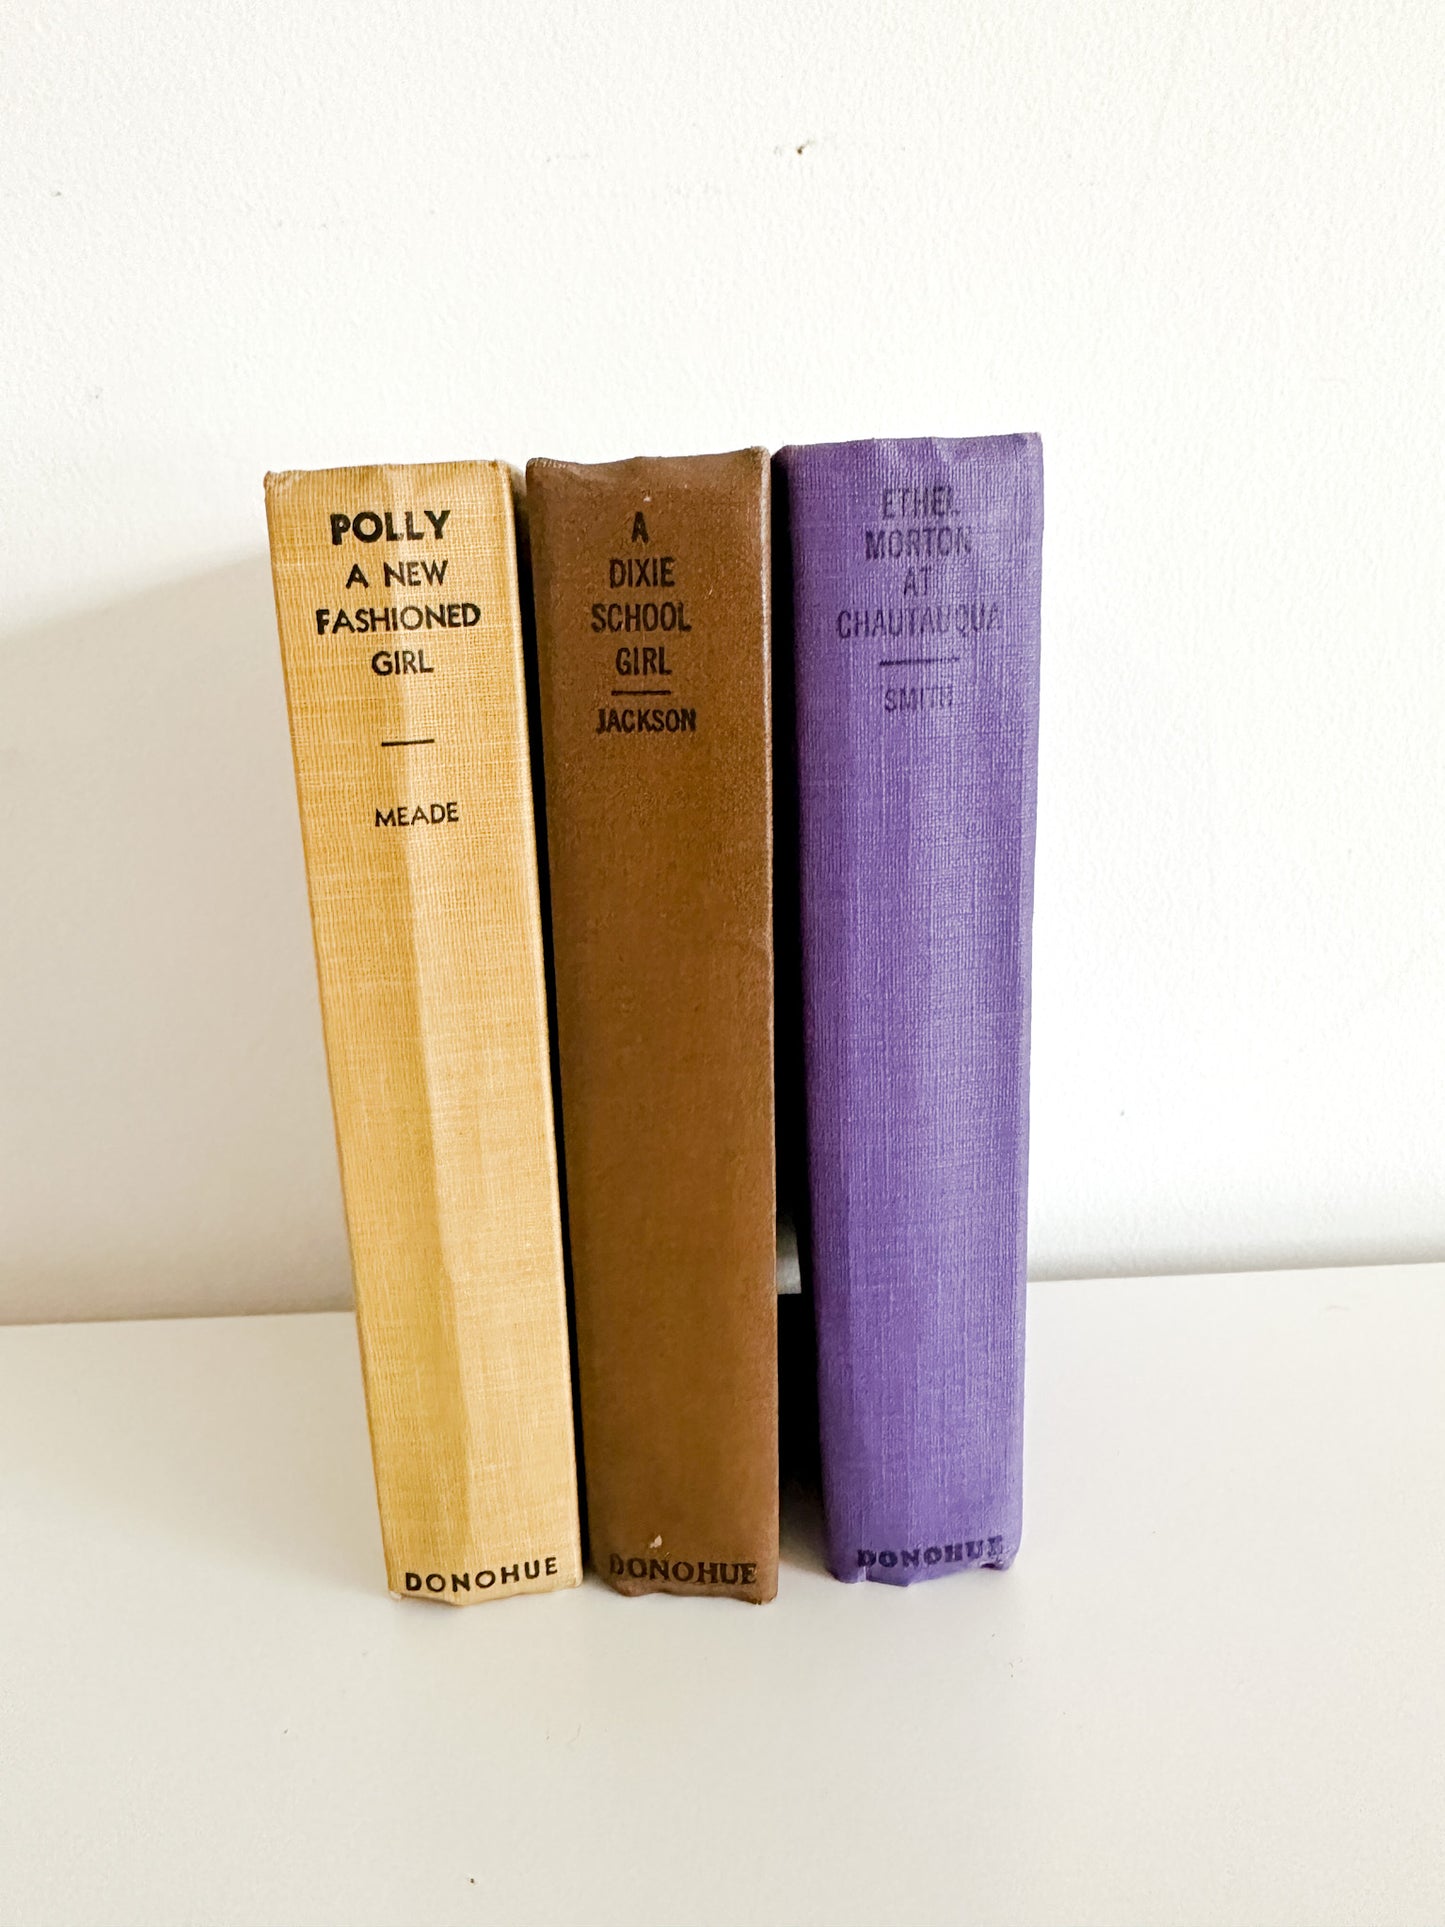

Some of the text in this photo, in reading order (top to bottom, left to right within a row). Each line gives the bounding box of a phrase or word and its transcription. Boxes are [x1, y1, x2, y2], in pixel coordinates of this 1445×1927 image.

[330, 509, 450, 545] POLLY
[631, 511, 649, 543] A
[865, 526, 973, 560] MORTON
[345, 560, 449, 589] A NEW
[609, 556, 676, 588] DIXIE
[903, 566, 932, 597] AT
[316, 602, 481, 635] FASHIONED
[591, 601, 692, 633] SCHOOL
[837, 601, 1001, 638] CHAUTAUQUA
[371, 649, 434, 676] GIRL
[615, 646, 673, 676] GIRL
[595, 707, 697, 735] JACKSON
[374, 801, 460, 827] MEADE
[857, 1534, 1004, 1568] DONOHUE
[404, 1556, 559, 1593] DONOHUE
[609, 1552, 758, 1587] DONOHUE
